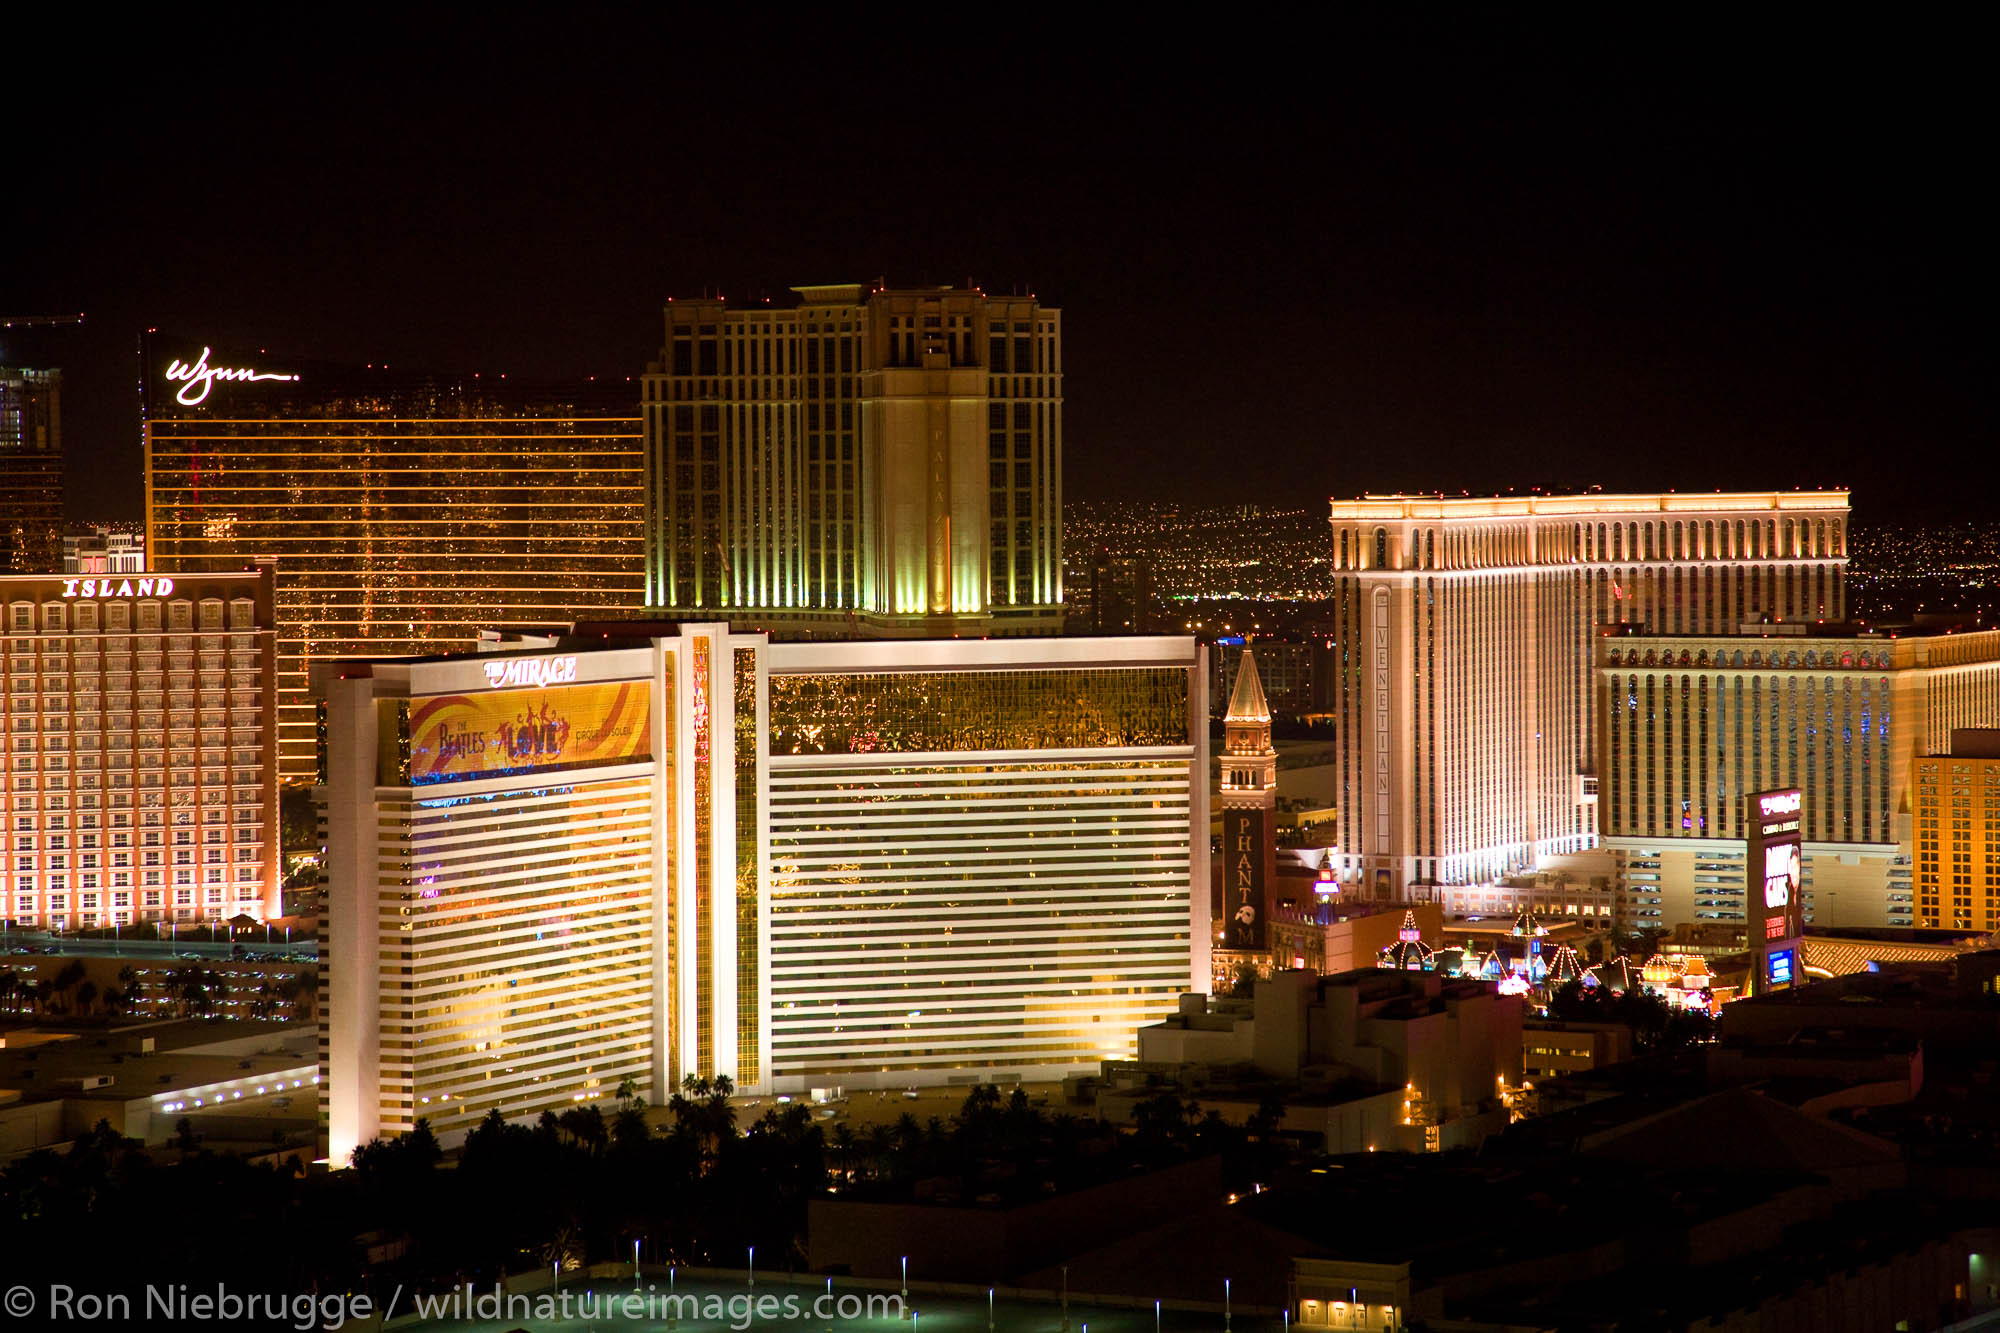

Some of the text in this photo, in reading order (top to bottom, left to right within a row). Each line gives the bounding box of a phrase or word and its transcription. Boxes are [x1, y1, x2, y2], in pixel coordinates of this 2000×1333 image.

[62, 578, 174, 598] ISLAND
[490, 656, 577, 688] MIRAGE
[1378, 630, 1387, 790] VENETIAN
[440, 722, 486, 759] BEATLES
[507, 724, 560, 758] LOVE
[1237, 818, 1254, 945] PHANTM
